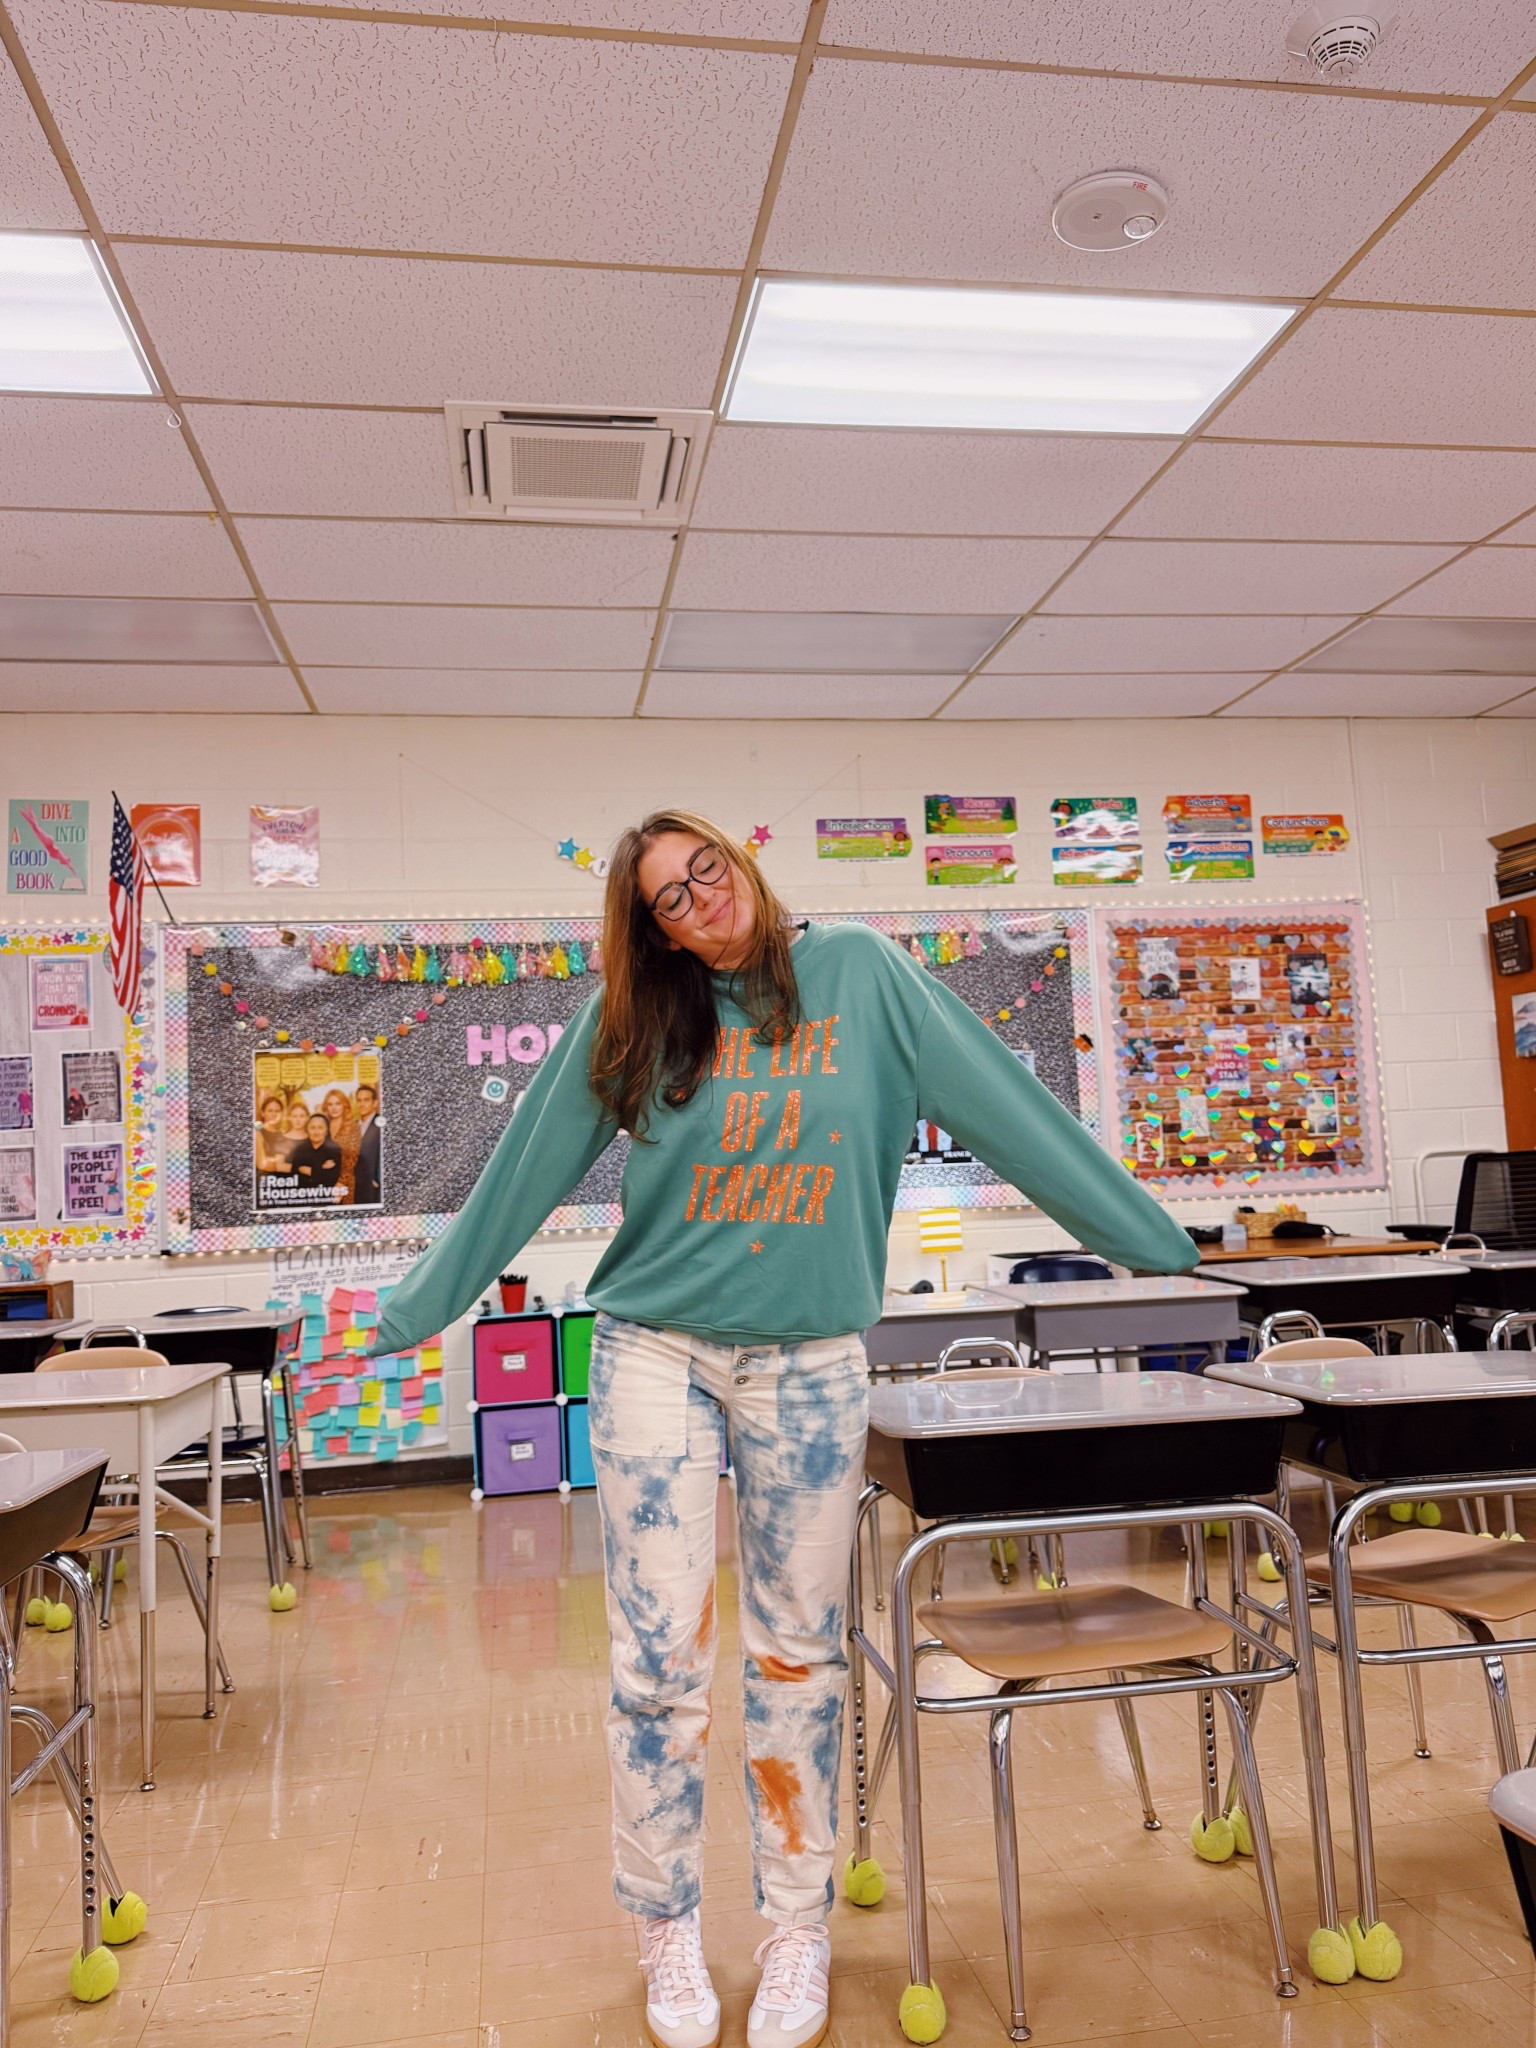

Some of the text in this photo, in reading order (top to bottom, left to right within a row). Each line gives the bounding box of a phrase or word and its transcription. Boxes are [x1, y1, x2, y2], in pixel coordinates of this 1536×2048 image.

[1133, 181, 1148, 191] FIRE
[1093, 799, 1122, 809] Verbs
[1187, 797, 1226, 806] Adverbs
[41, 803, 72, 820] DIVE
[826, 820, 894, 833] Interjections
[1266, 817, 1329, 828] Conjunctions
[11, 827, 20, 844] A
[55, 826, 86, 843] INTO
[9, 849, 48, 867] GOOD
[945, 848, 993, 857] Pronouns
[16, 872, 55, 889] BOOK
[69, 963, 84, 972] ALL
[45, 984, 64, 993] THAT
[45, 994, 58, 1003] ALL
[38, 1004, 77, 1017] CROWNS!
[697, 1015, 840, 1078] HE LIFE
[9, 1062, 27, 1070] walk
[1214, 1061, 1236, 1069] ALSO
[1217, 1070, 1240, 1079] STAR
[81, 1082, 116, 1092] gonna
[88, 1091, 117, 1101] grow
[720, 1089, 801, 1152] OF A
[70, 1149, 117, 1160] THE BEST
[70, 1161, 114, 1173] PEOPLE
[70, 1173, 104, 1184] IN LIFE
[267, 1174, 299, 1187] Real
[78, 1185, 97, 1194] ARE
[259, 1184, 349, 1200] Housewives
[684, 1163, 835, 1225] TEACHER
[71, 1196, 104, 1209] FREE!
[273, 1245, 387, 1272] PLATINUM
[275, 1271, 319, 1283] Language
[351, 1273, 397, 1283] classroom
